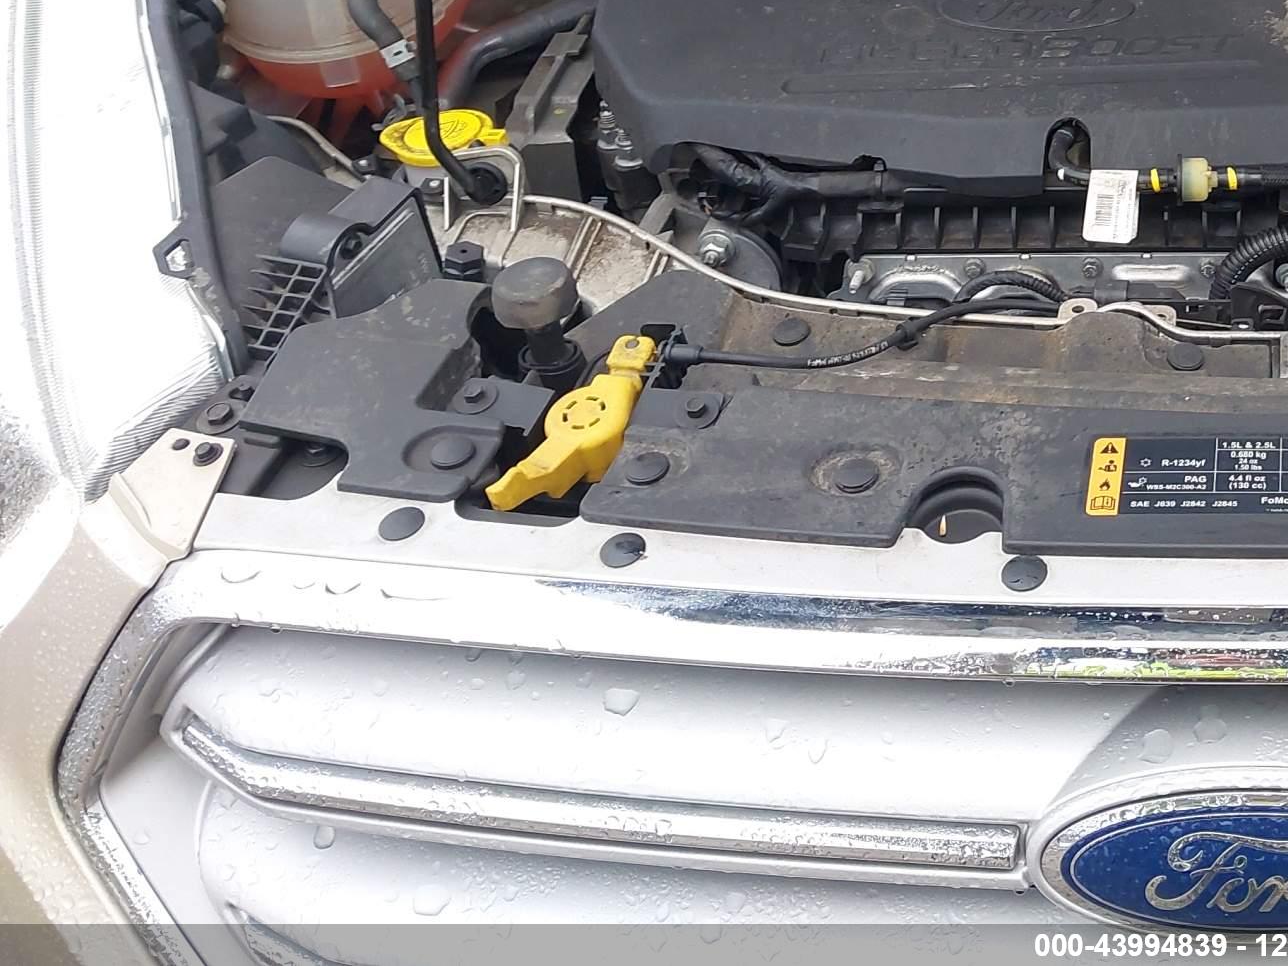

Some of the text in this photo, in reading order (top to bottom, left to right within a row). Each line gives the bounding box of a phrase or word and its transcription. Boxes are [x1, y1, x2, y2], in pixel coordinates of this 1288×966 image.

[1222, 441, 1277, 449] 1.5L & 2.5L
[1255, 451, 1267, 460] kg
[1161, 458, 1207, 468] R-1234yf
[1184, 475, 1207, 483] PAG
[1228, 482, 1267, 490] (130 cc)
